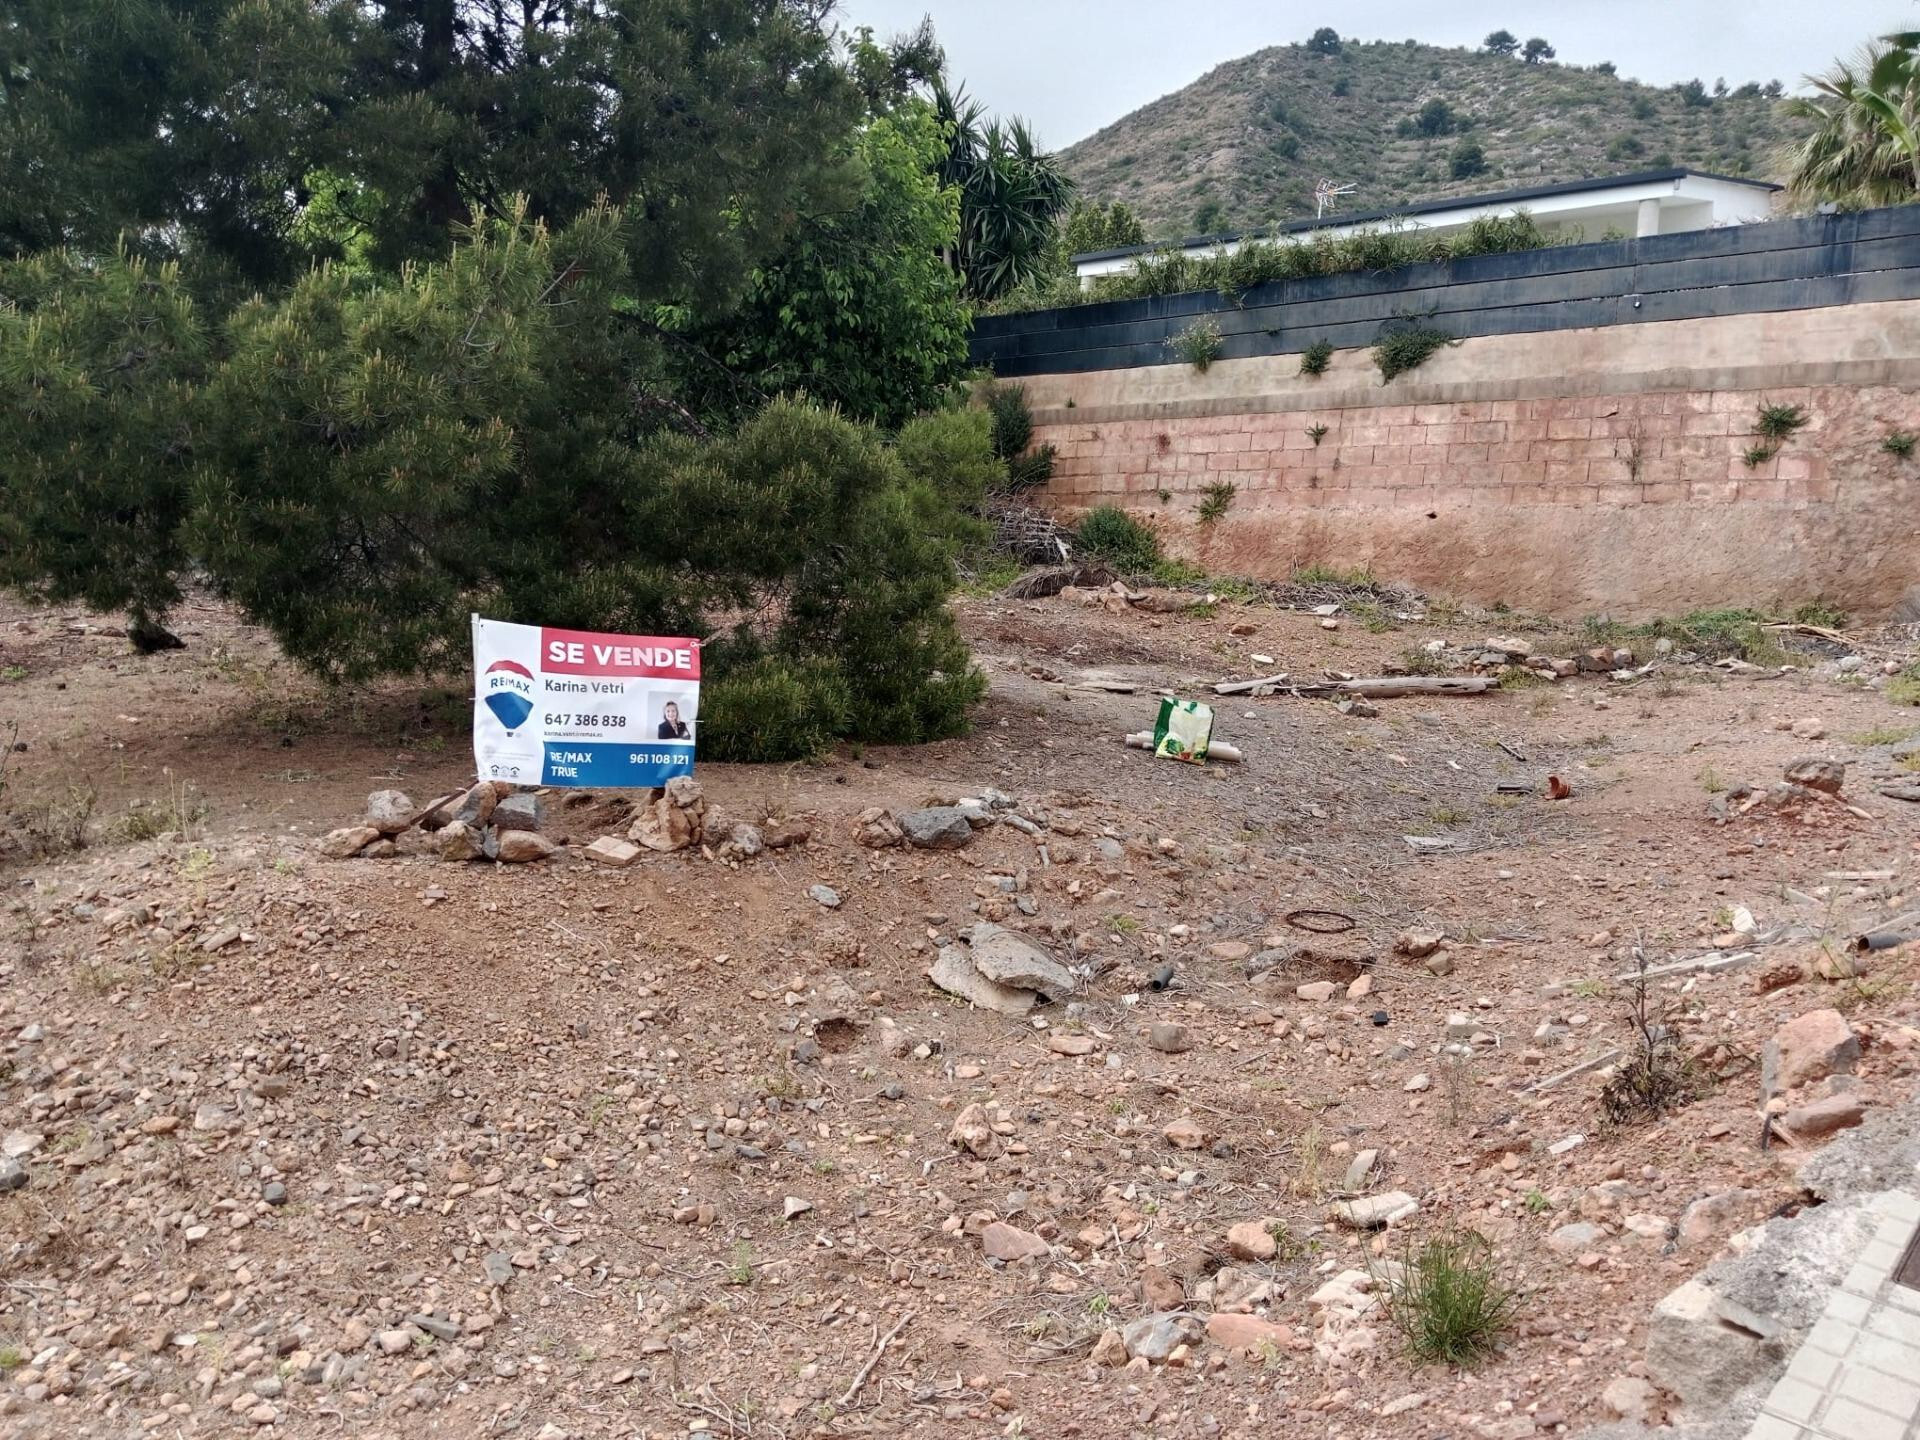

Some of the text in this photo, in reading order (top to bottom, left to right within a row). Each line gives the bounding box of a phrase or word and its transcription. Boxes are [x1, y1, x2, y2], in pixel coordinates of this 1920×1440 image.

[549, 641, 691, 669] SE VENDE
[545, 679, 624, 694] Karina Vetri
[544, 713, 627, 728] 647 386 838
[550, 751, 592, 763] RE/MAX
[630, 753, 689, 765] 961 108 121
[551, 766, 578, 778] TRUE
